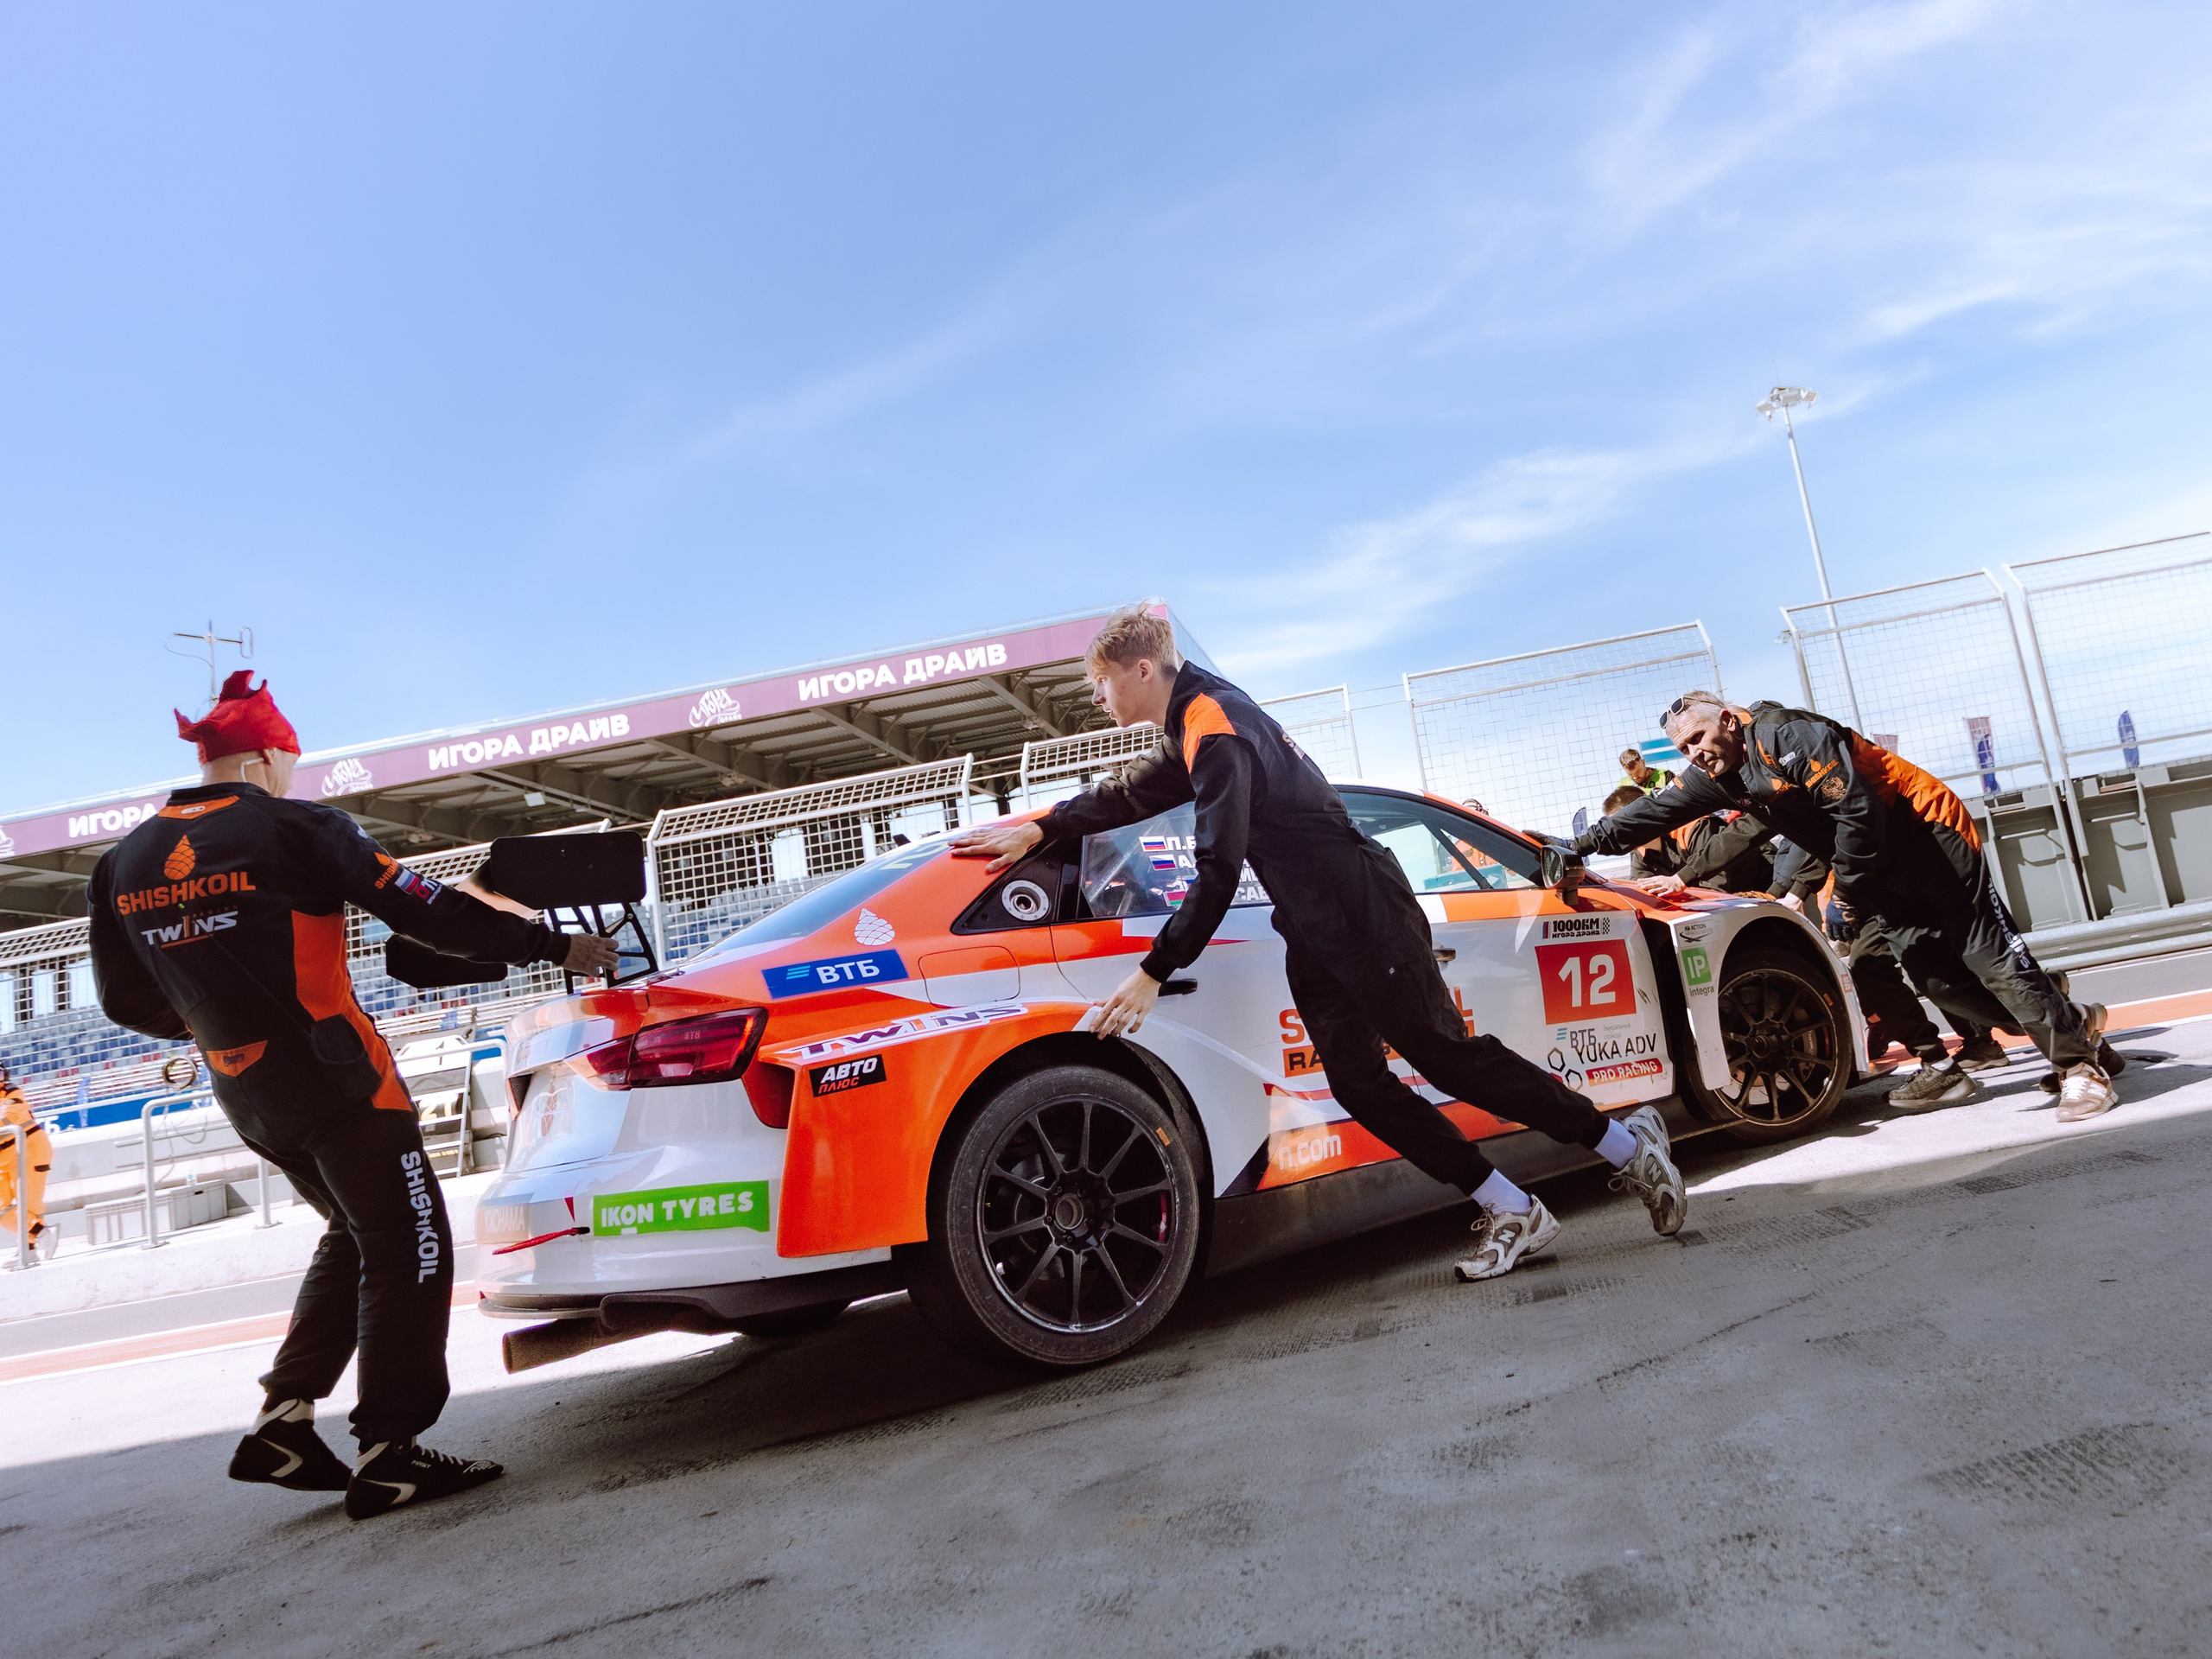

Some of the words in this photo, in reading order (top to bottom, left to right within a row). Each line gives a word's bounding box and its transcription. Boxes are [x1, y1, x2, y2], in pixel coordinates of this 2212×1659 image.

[798, 664, 897, 701] ИГОРА
[903, 644, 1007, 684] ДРАЙВ
[429, 734, 523, 771] ИГОРА
[529, 714, 630, 755] ДРАЙВ
[68, 804, 157, 838] ИГОРА
[117, 872, 256, 915] SHISHKOIL
[141, 911, 238, 945] TWINS
[816, 959, 880, 984] ВТБ
[1558, 954, 1616, 1007] 12
[1687, 955, 1706, 979] IP
[1689, 986, 1715, 997] integra
[1570, 1027, 1597, 1048] ВТБ
[1574, 1039, 1622, 1065] YUKA
[1625, 1033, 1656, 1057] ADV
[818, 1077, 859, 1094] ПЛЮС
[821, 1057, 877, 1084] АВТО
[1592, 1068, 1616, 1084] PRO
[1618, 1060, 1659, 1079] RACING
[400, 1150, 439, 1283] SHISHKOIL
[601, 1201, 654, 1228] IKON
[661, 1191, 753, 1221] TYRES
[410, 1459, 432, 1469] FIRST
